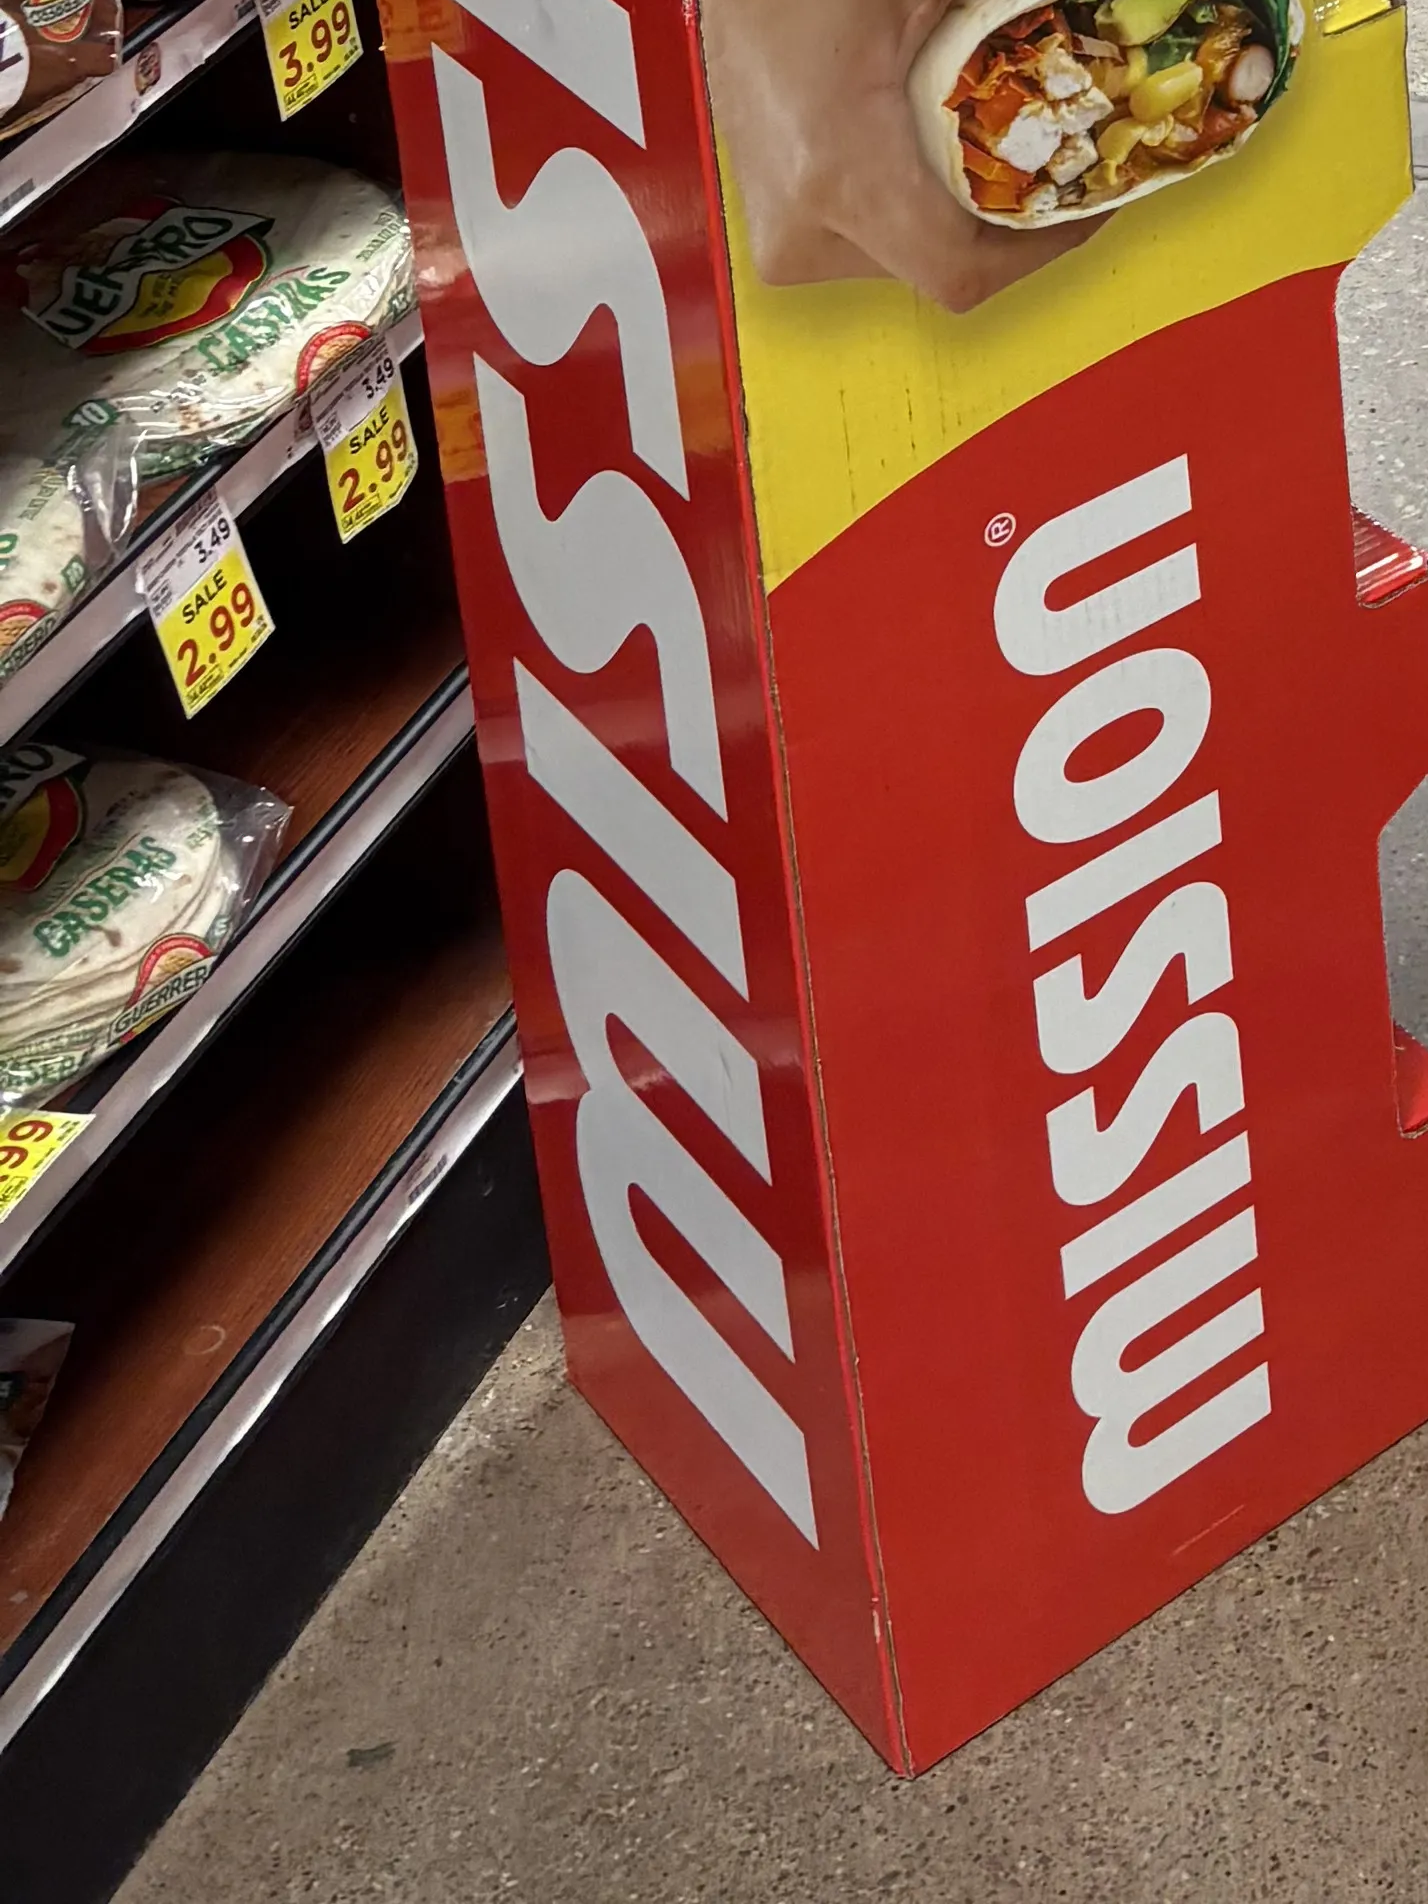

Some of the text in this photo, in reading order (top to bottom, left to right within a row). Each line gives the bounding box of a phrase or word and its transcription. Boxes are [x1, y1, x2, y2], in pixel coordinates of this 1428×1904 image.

[278, 0, 351, 89] 3.99
[361, 356, 395, 400] 3.49
[348, 404, 390, 456] SALE
[337, 418, 408, 514] 2.99
[193, 516, 231, 565] 3.49
[181, 567, 228, 626] SALE
[176, 581, 256, 689] 2.99
[113, 965, 207, 1036] GUERRER
[992, 452, 1274, 1516] MISSION
